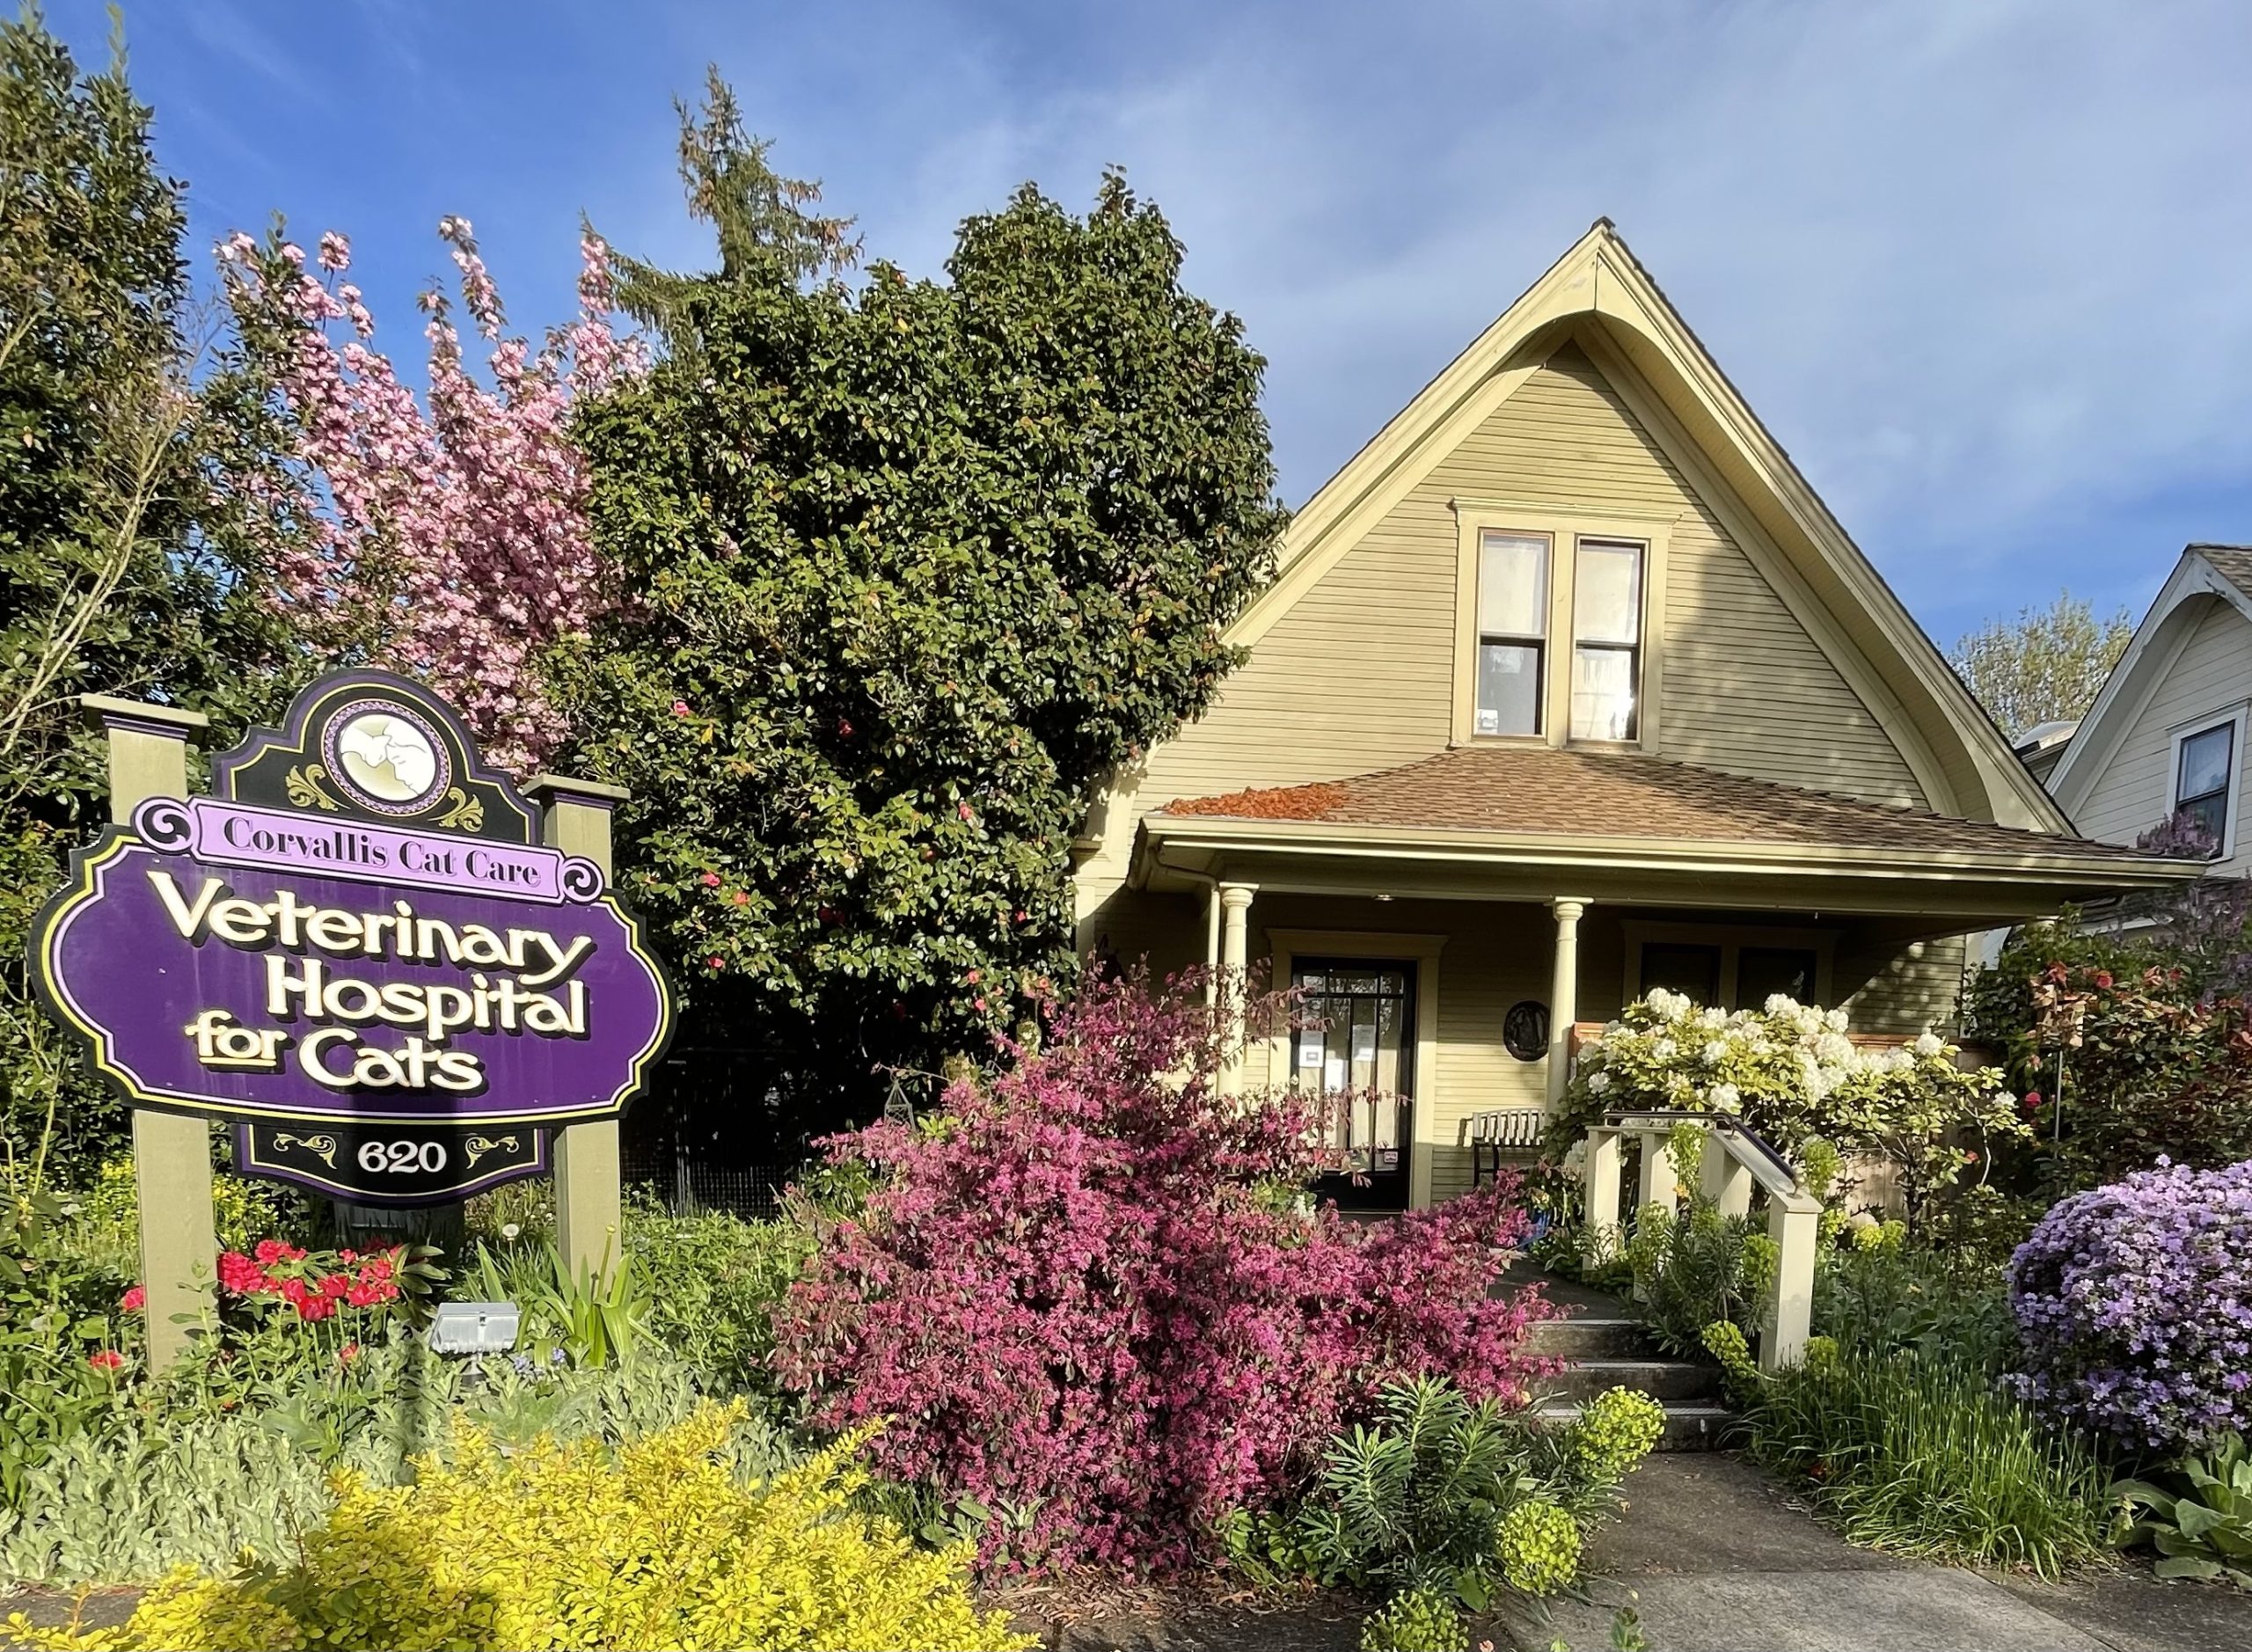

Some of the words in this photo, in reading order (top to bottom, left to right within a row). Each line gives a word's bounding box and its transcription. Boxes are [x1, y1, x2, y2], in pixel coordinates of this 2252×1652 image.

[223, 815, 388, 867] Corvallis
[398, 841, 457, 874] Cat
[464, 850, 541, 887] Care
[146, 870, 592, 984] Veterinary
[264, 954, 586, 1041] Hospital
[185, 1010, 287, 1061] for
[298, 1027, 483, 1090] Cats
[357, 1140, 447, 1173] 620
